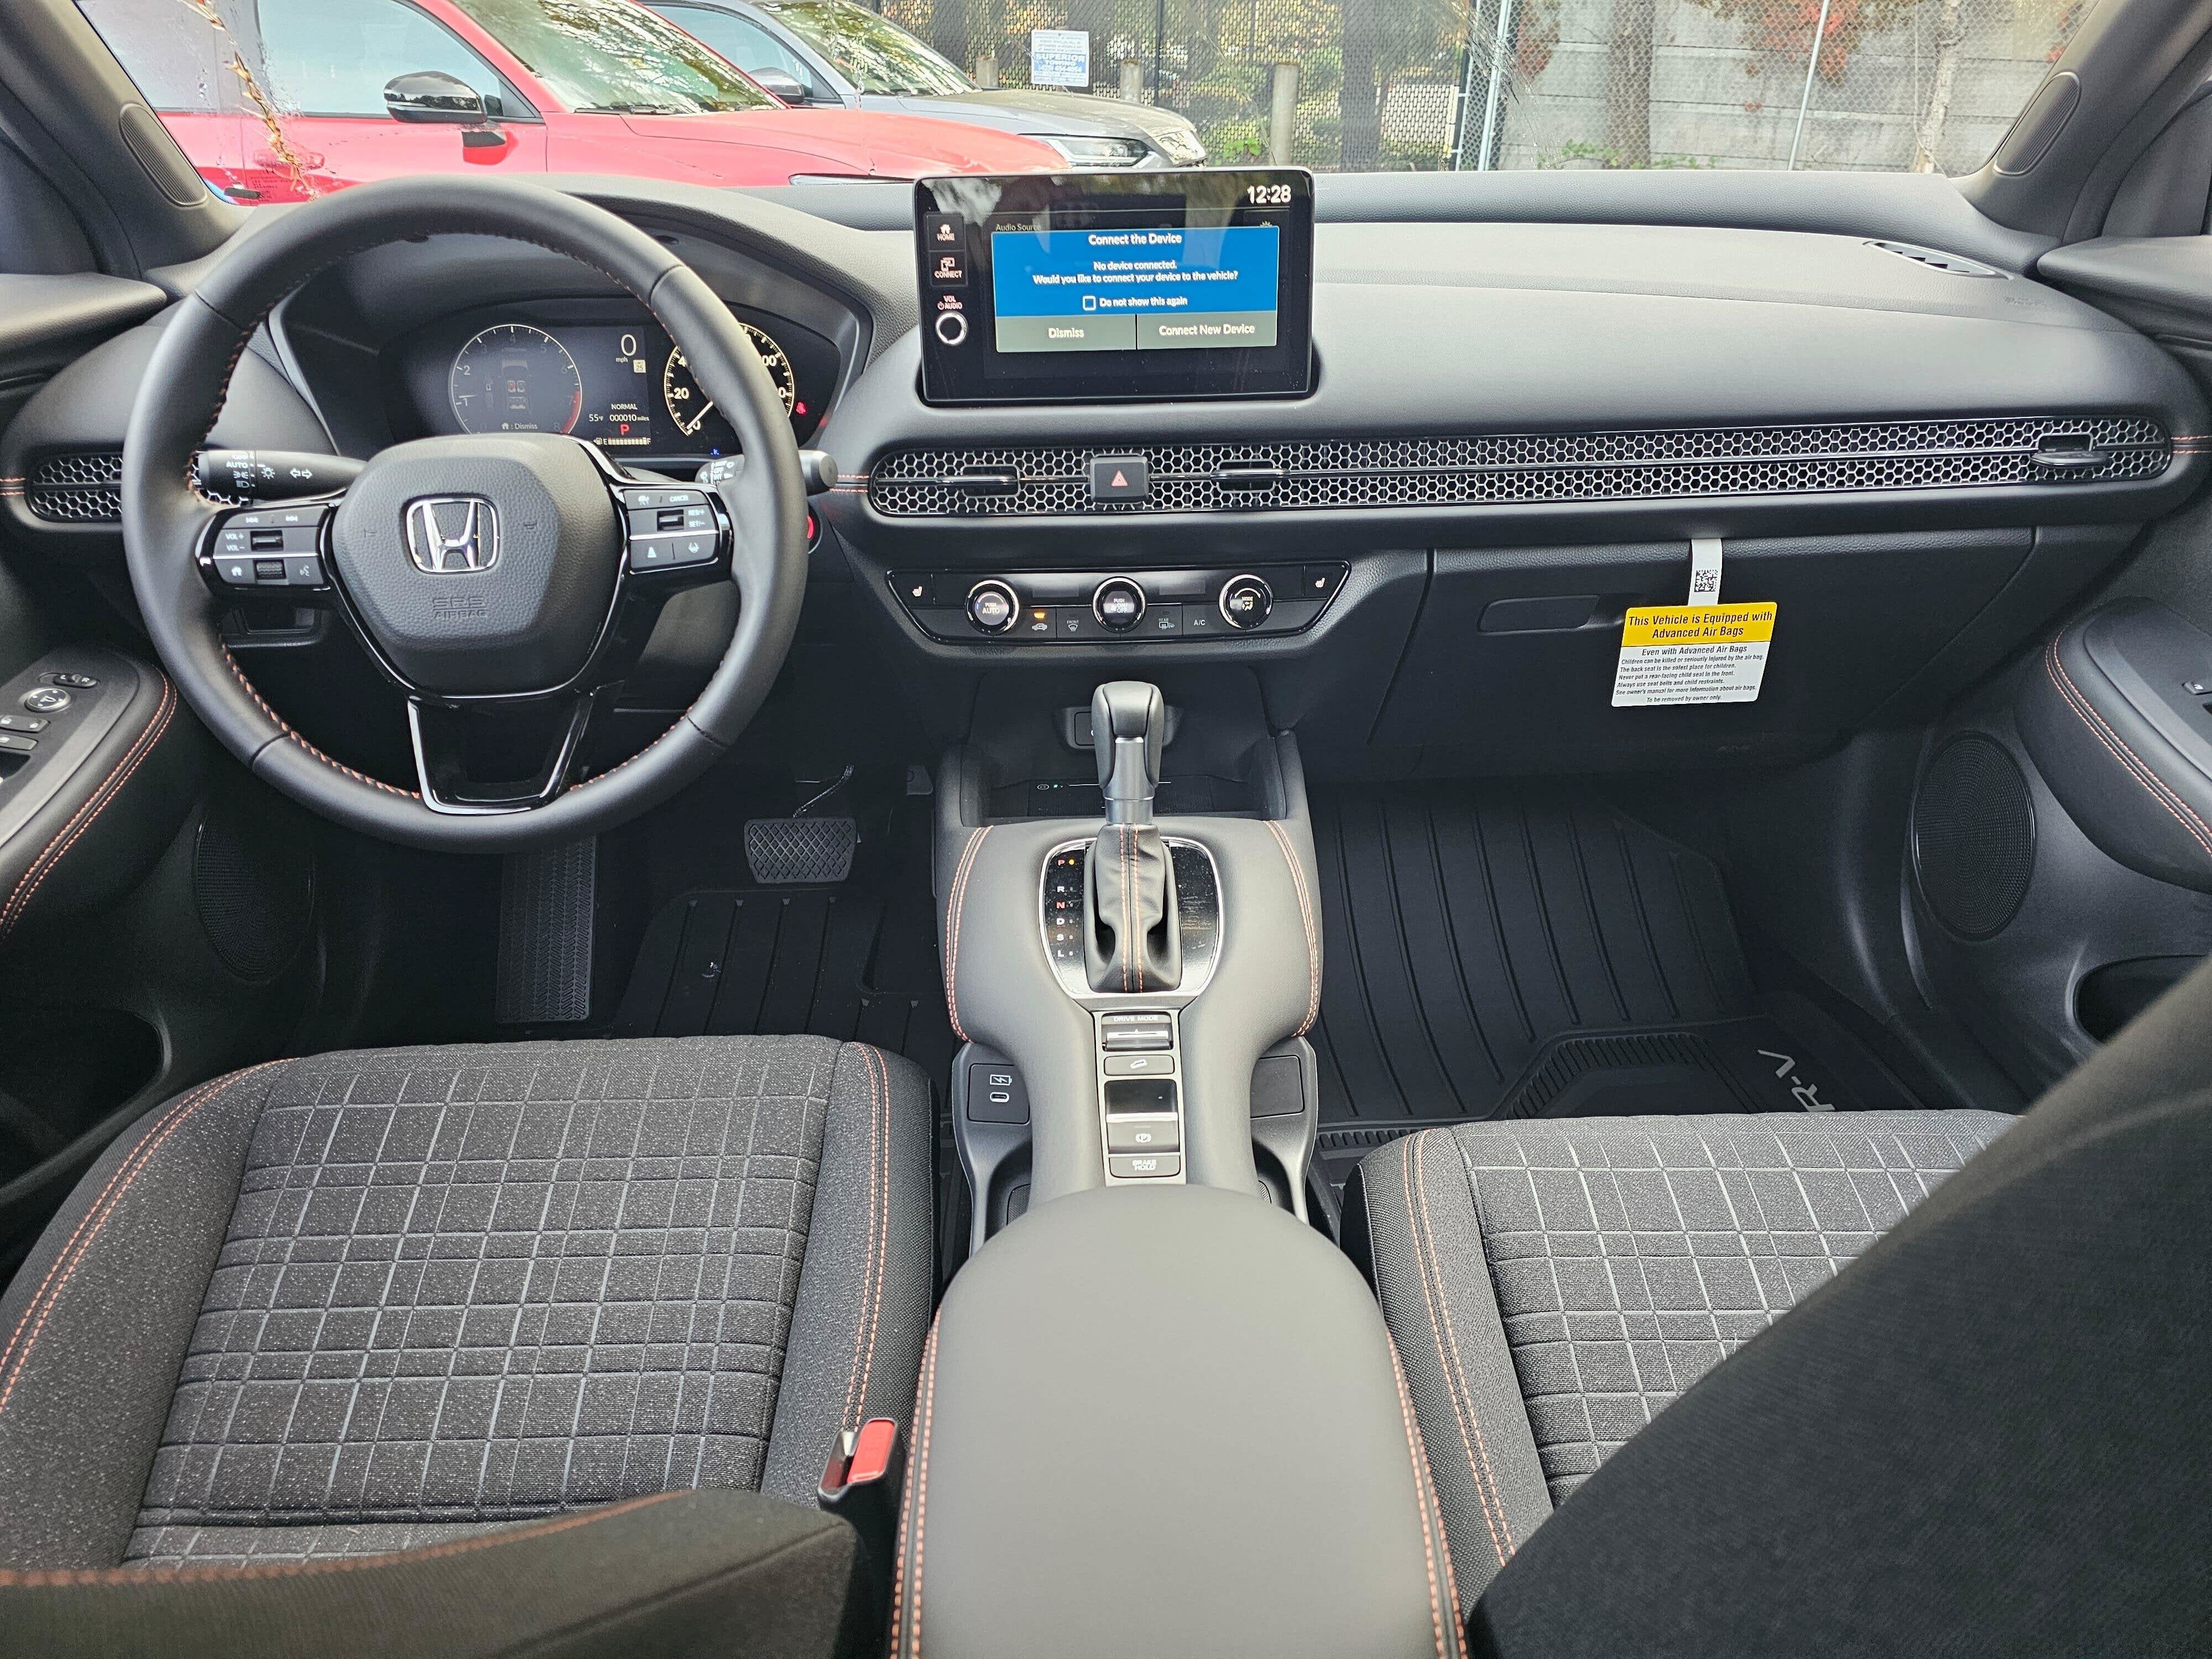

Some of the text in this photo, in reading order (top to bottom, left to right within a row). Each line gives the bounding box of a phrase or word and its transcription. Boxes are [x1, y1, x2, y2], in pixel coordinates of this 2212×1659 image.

[1247, 185, 1291, 204] 12:28
[1088, 233, 1182, 245] Connect the Device
[1093, 260, 1177, 271] No device connected.
[1032, 270, 1238, 285] Would you like to connect your device to the vehicle?
[1099, 296, 1188, 307] Do not show this again
[1048, 327, 1084, 338] Dismiss
[1159, 324, 1255, 336] Connect New Device
[621, 334, 636, 356] 0
[463, 366, 470, 375] 2
[674, 388, 690, 399] 20
[463, 398, 468, 406] 1
[620, 424, 629, 435] P
[432, 597, 486, 608] SRS
[1629, 612, 1772, 625] This Vehicle is Equipped with
[1652, 627, 1744, 638] Advanced Air Bags
[1679, 646, 1715, 654] Advanced
[1729, 645, 1747, 654] Bags
